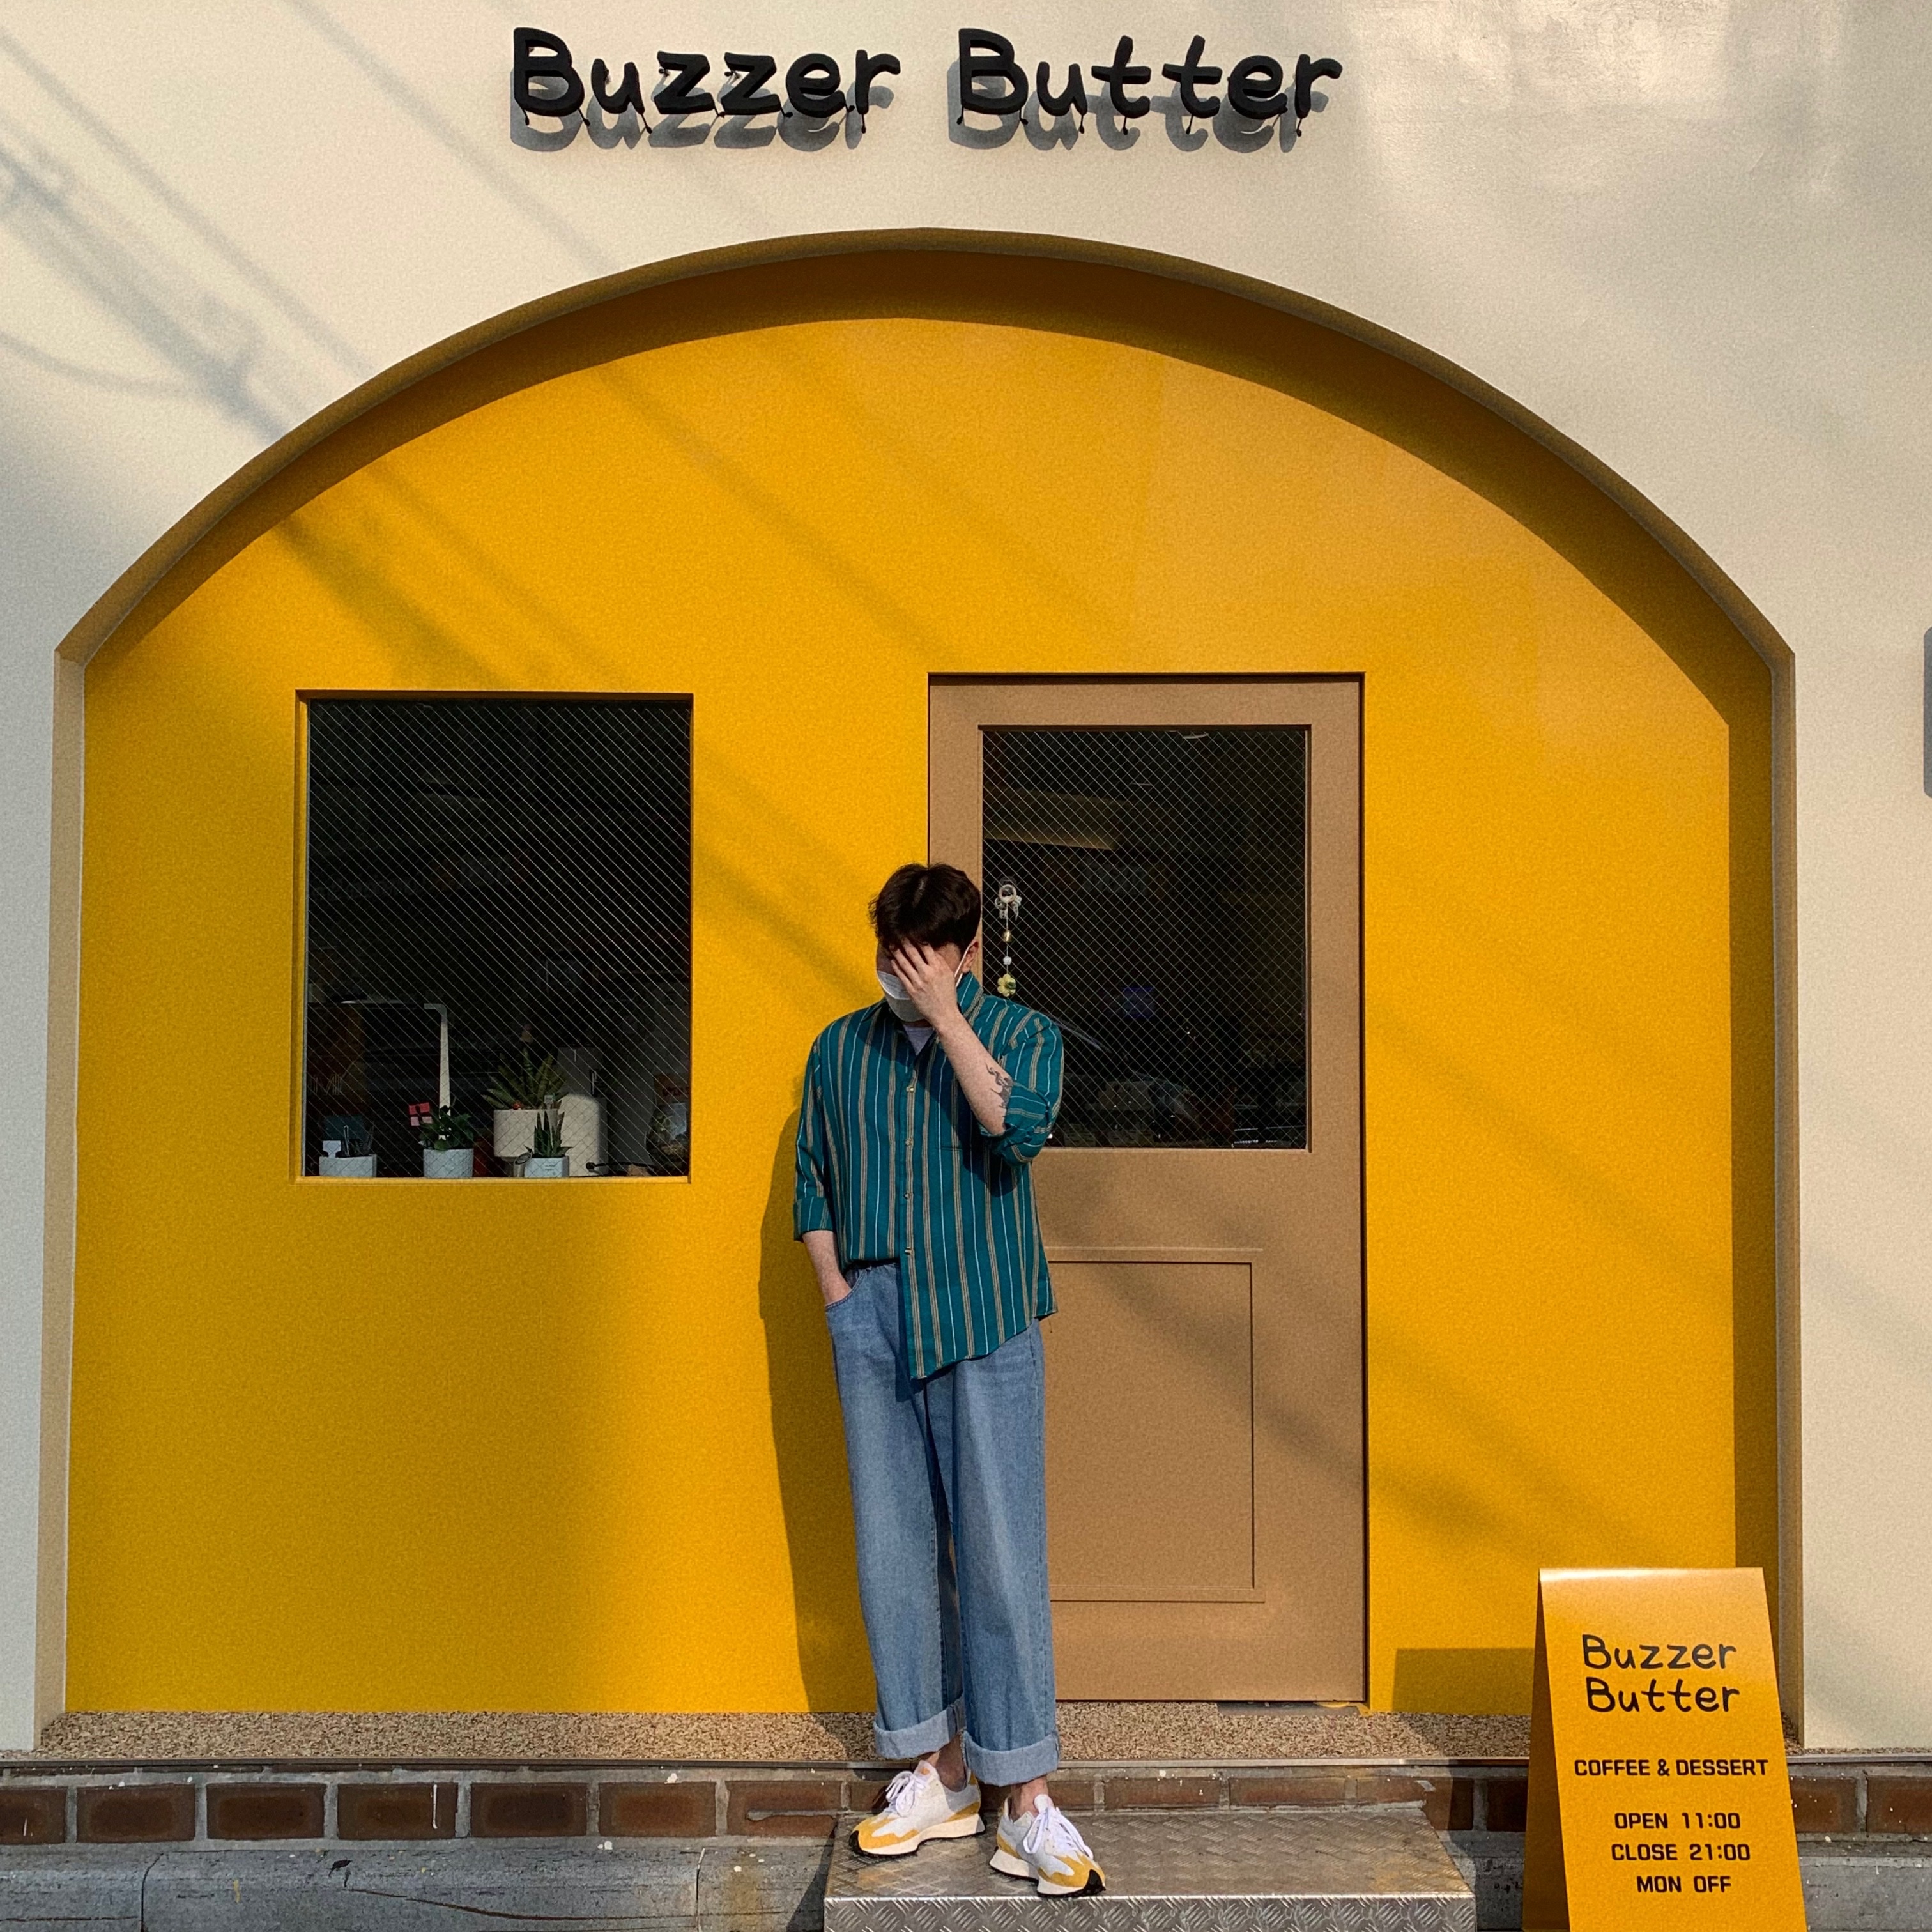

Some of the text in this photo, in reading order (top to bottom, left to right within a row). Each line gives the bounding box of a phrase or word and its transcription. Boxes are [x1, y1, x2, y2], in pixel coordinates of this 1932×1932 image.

[514, 27, 1343, 118] Buzzer Butter
[1582, 1634, 1737, 1670] Buzzer
[1586, 1676, 1740, 1712] Butter
[1574, 1758, 1769, 1776] COFFEE & DESSERT
[1614, 1812, 1741, 1829] OPEN 11:00
[1611, 1844, 1751, 1861] CLOSE 21:00
[1636, 1876, 1732, 1893] MON OFF
